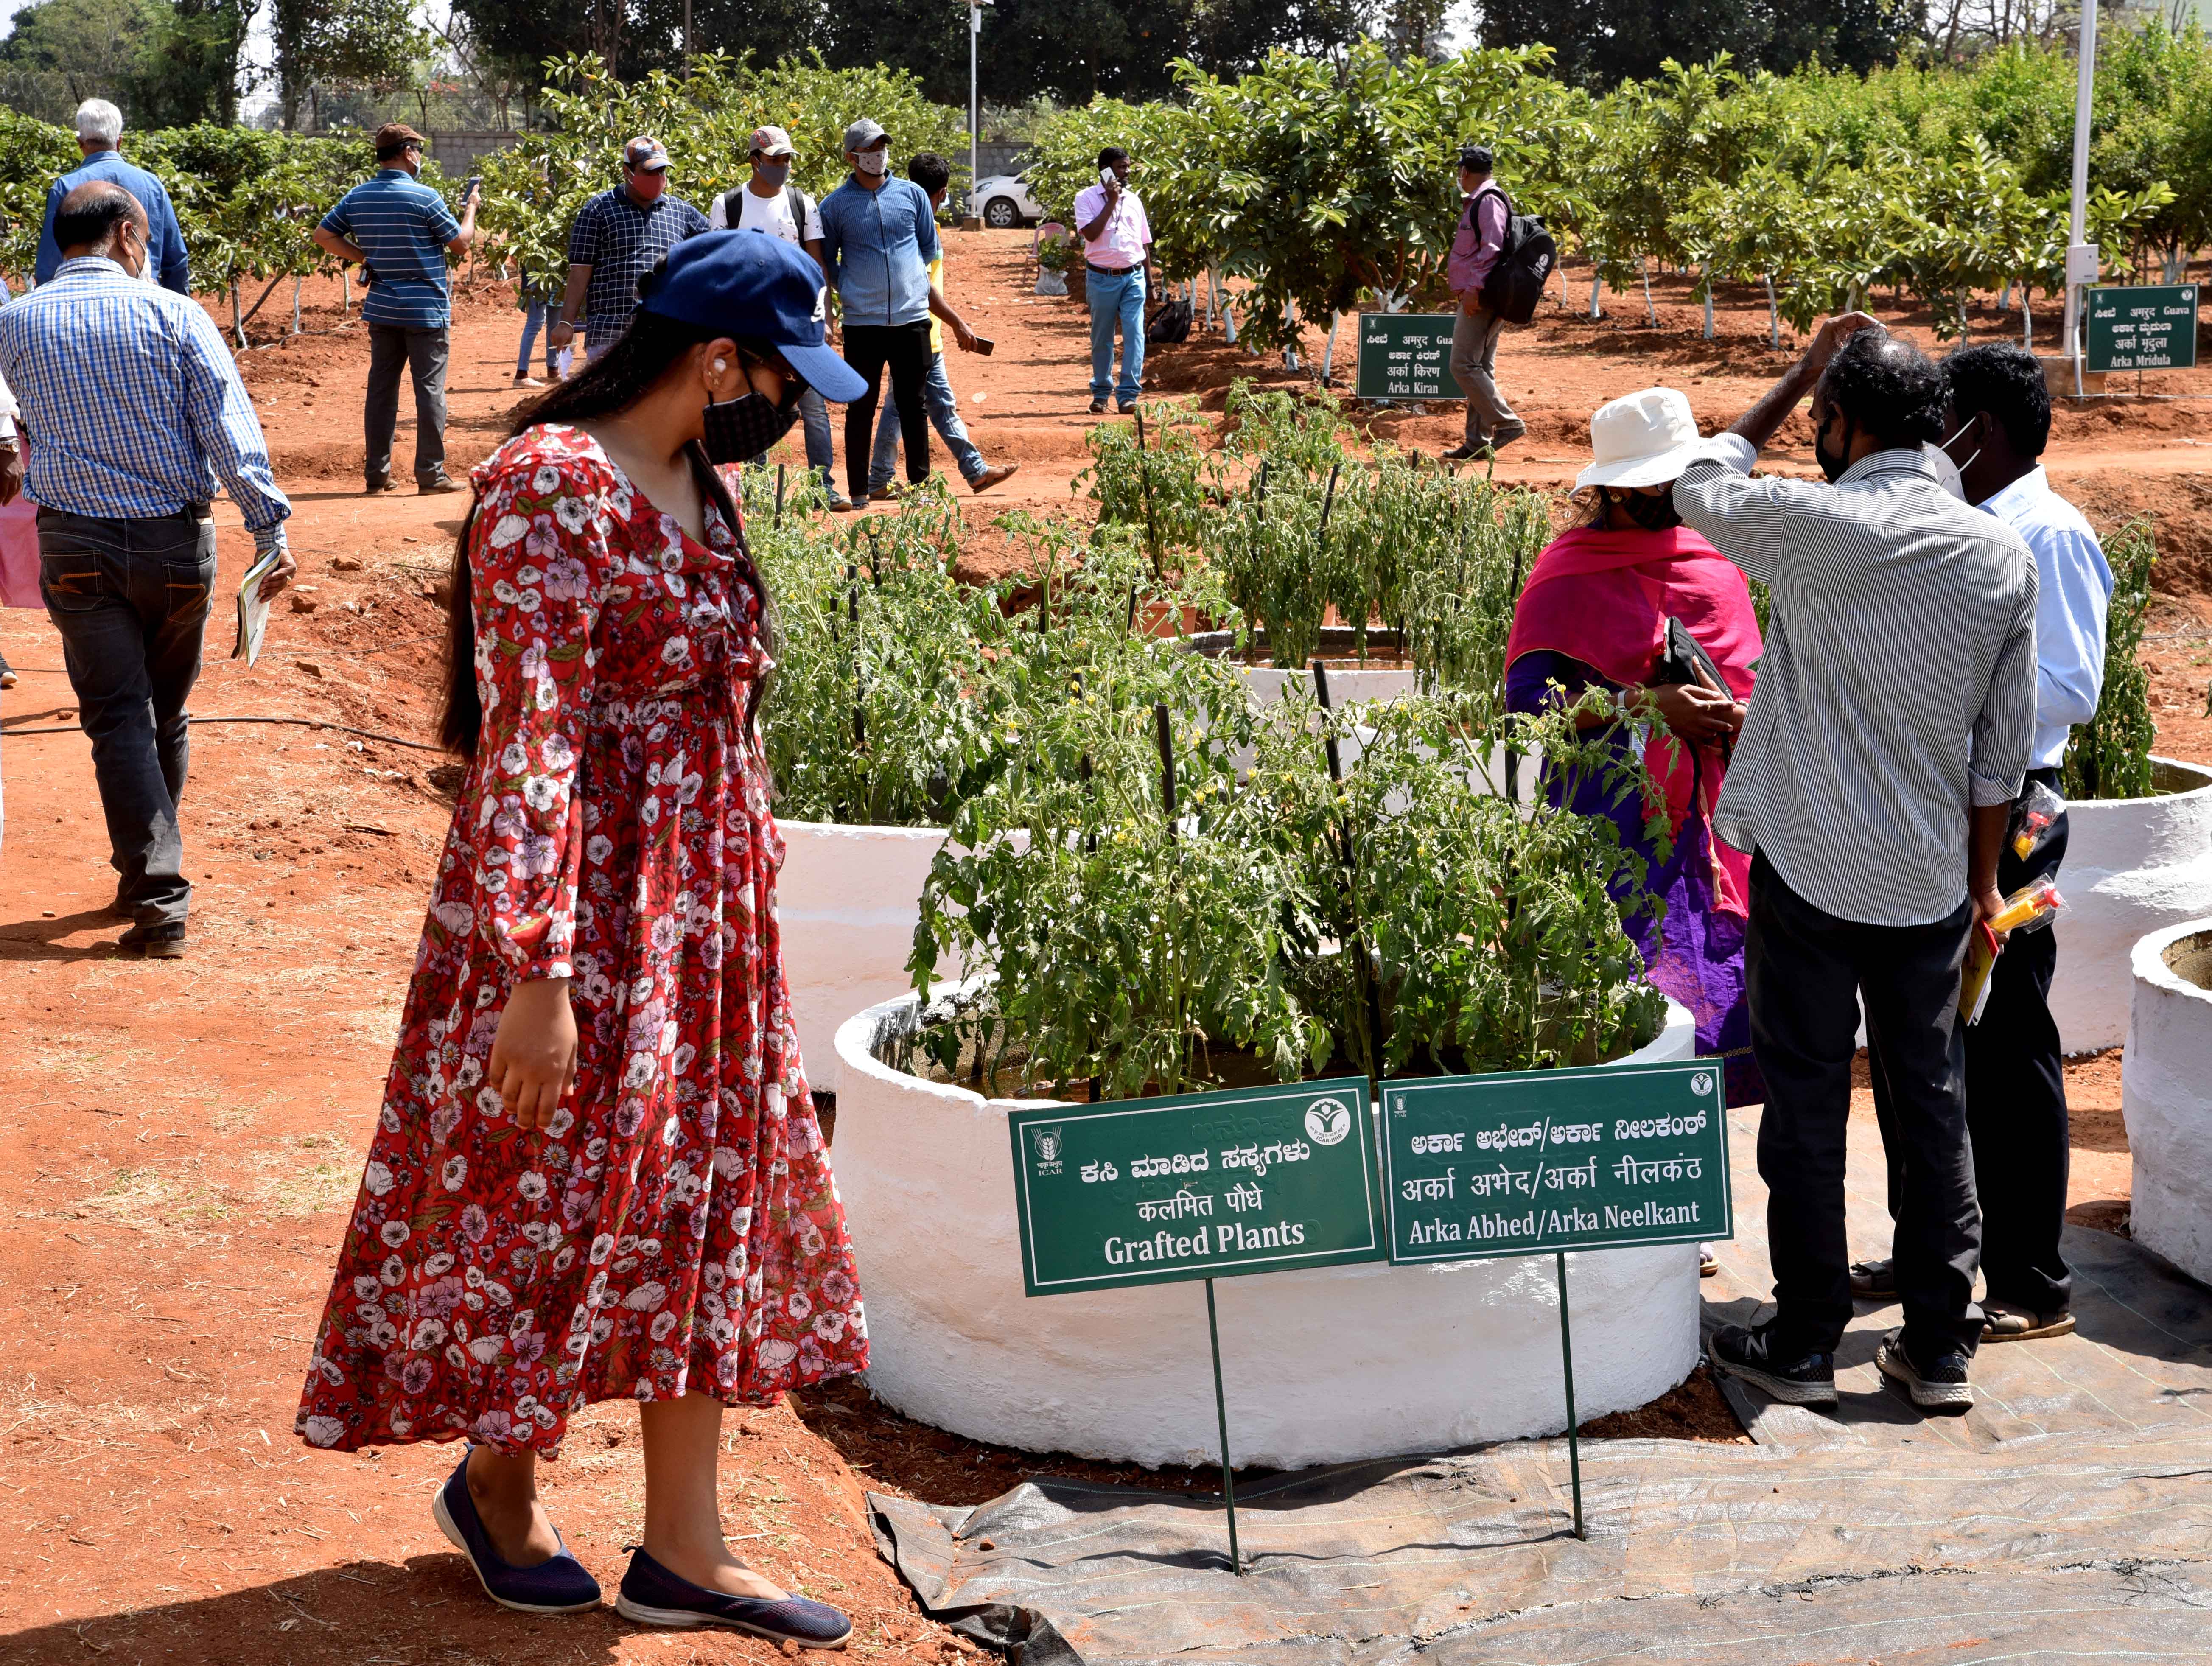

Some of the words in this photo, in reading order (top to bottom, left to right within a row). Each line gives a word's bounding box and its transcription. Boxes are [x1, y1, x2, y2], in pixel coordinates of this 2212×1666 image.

[2164, 306, 2189, 315] Guava
[1436, 336, 1453, 344] Gua
[2115, 335, 2136, 349] अर्का
[2111, 356, 2132, 367] Arka
[2136, 354, 2170, 366] Mridula
[1387, 363, 1408, 377] अर्का
[1414, 363, 1440, 377] किरण
[1388, 381, 1409, 393] Arka
[1414, 382, 1438, 393] Kiran
[1316, 1134, 1343, 1143] ICAR-IIHR
[1412, 1133, 1465, 1154] ಅರ್ಕಾ
[1615, 1110, 1706, 1140] ನೀಲಕಂಠ್
[1081, 1159, 1118, 1182] ಕಸಿ
[1131, 1148, 1209, 1178] ಮಾಡಿದ
[1221, 1138, 1310, 1176] ಸಸ್ಯಗಳು
[1402, 1168, 1455, 1201] अर्का
[1612, 1153, 1702, 1184] नीलकंठ
[1136, 1189, 1213, 1221] कलमित
[1224, 1182, 1263, 1212] पौधे
[1409, 1218, 1461, 1244] Arka
[1604, 1201, 1700, 1228] Neelkant
[1105, 1226, 1210, 1264] Grafted
[1217, 1221, 1304, 1252] Plants
